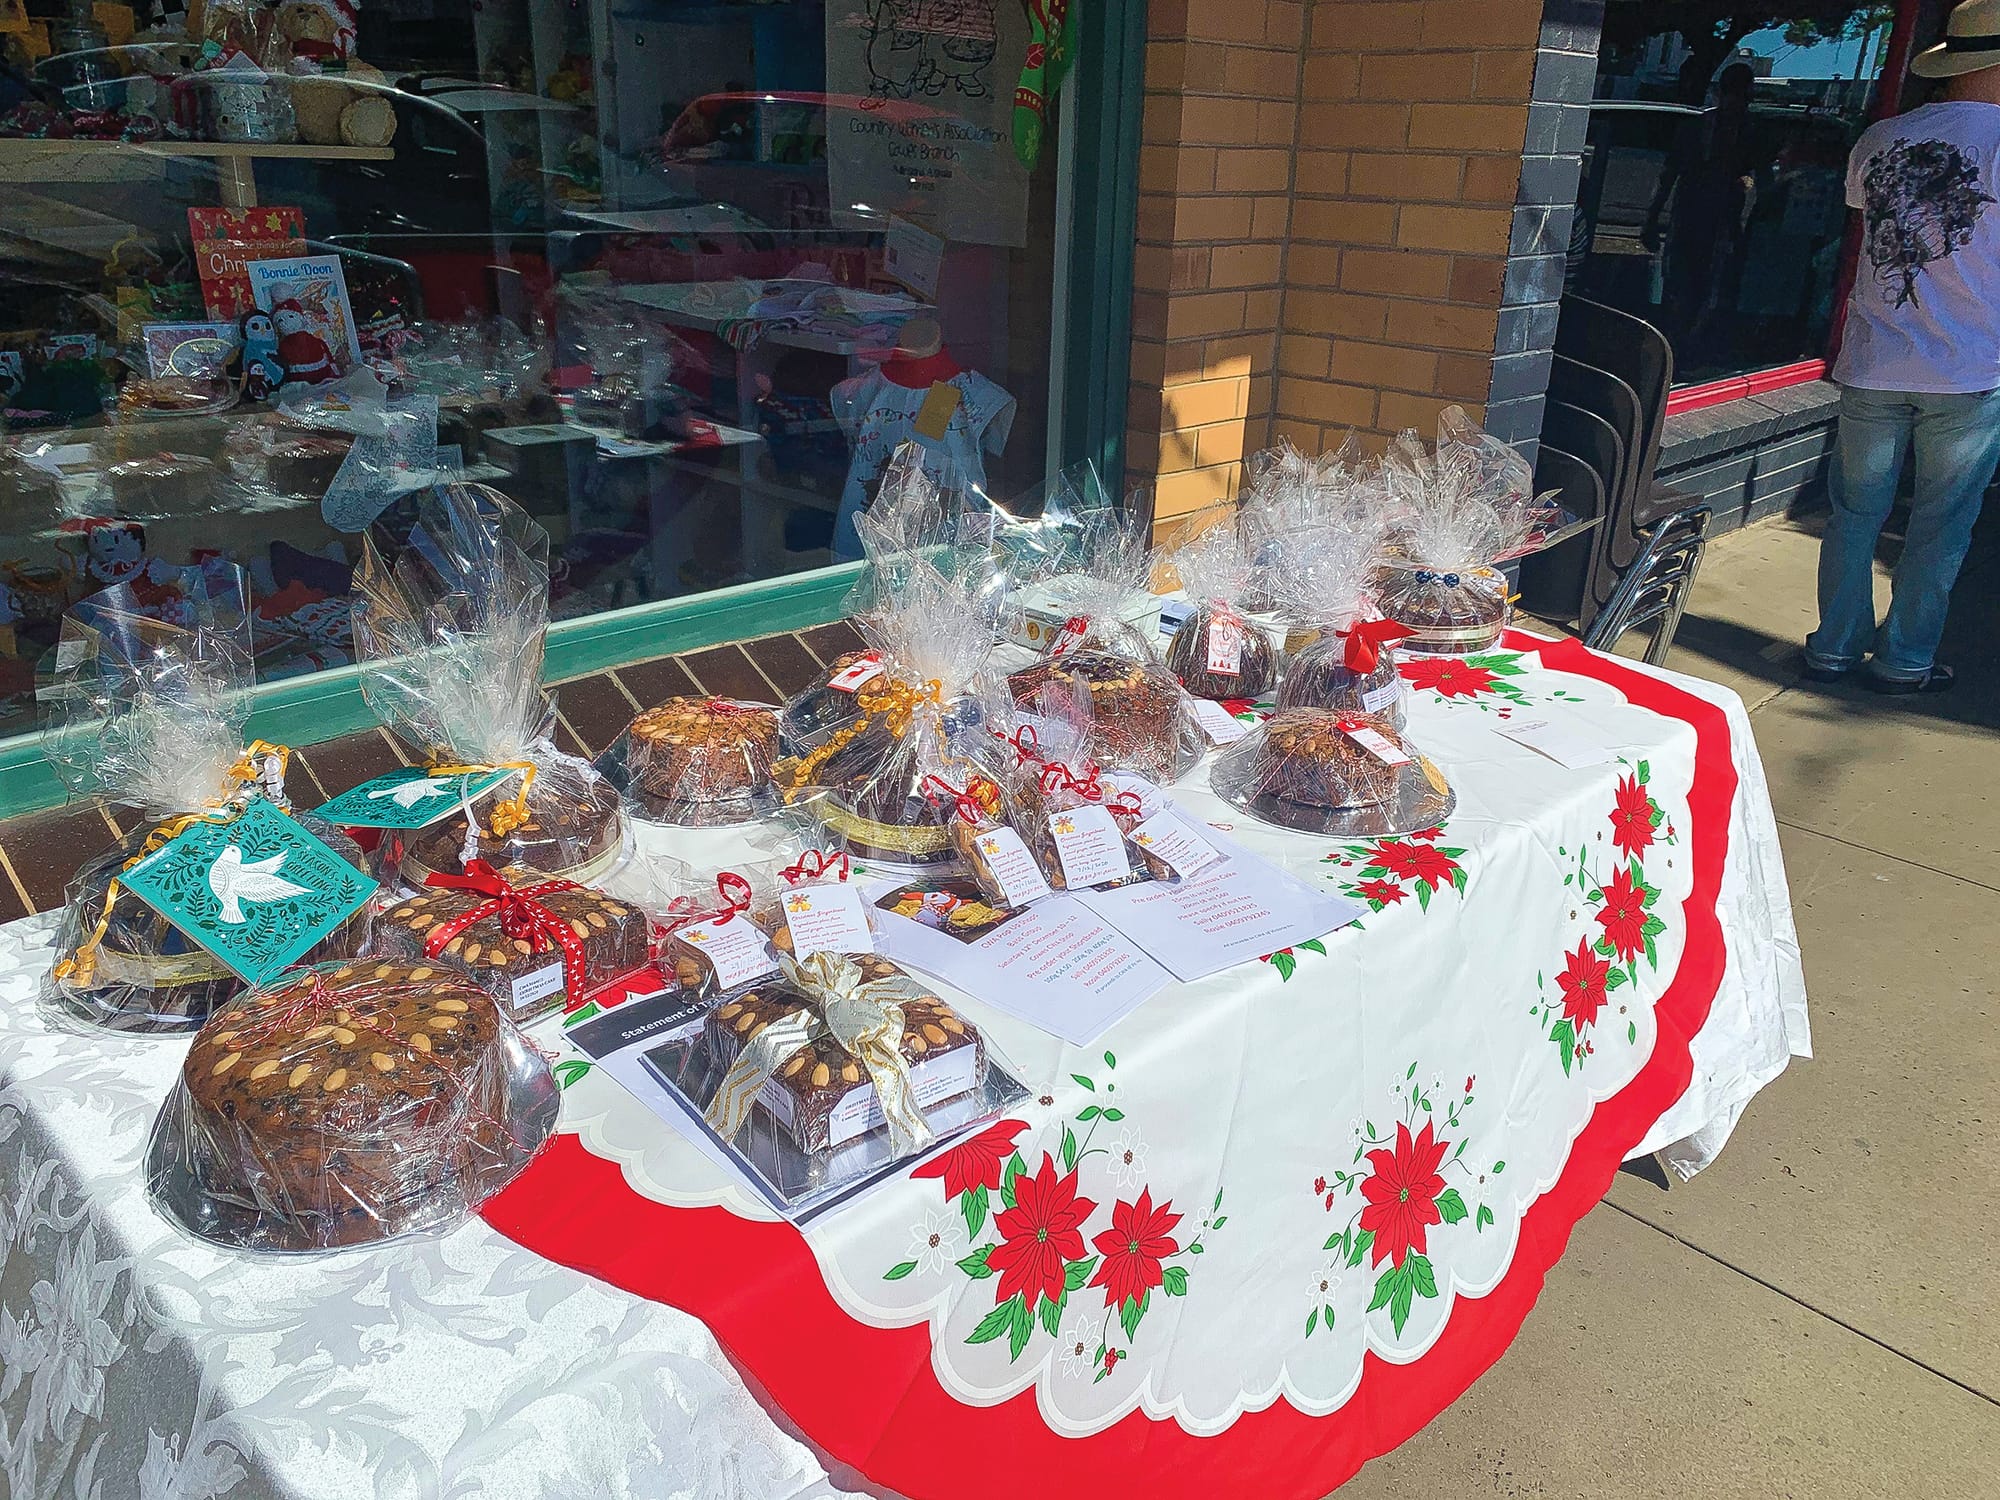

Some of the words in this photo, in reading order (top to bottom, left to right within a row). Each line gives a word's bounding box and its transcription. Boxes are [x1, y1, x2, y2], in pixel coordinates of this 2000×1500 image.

[850, 117, 896, 139] Country
[258, 266, 300, 279] Bonnie
[301, 263, 334, 275] Doon
[286, 861, 335, 896] GREETINGS
[1131, 897, 1146, 905] Pre
[1146, 892, 1167, 901] order
[1193, 917, 1211, 926] Sally
[981, 936, 998, 949] CWA
[996, 929, 1012, 940] Pop
[998, 951, 1024, 968] Saturday
[1032, 929, 1058, 945] December
[1027, 969, 1041, 980] Pre
[1040, 958, 1057, 972] order
[1056, 948, 1072, 961] your
[1069, 927, 1104, 950] Shortbread
[1029, 948, 1049, 961] Cowes
[620, 1009, 687, 1040] Statement
[686, 1004, 701, 1015] of
